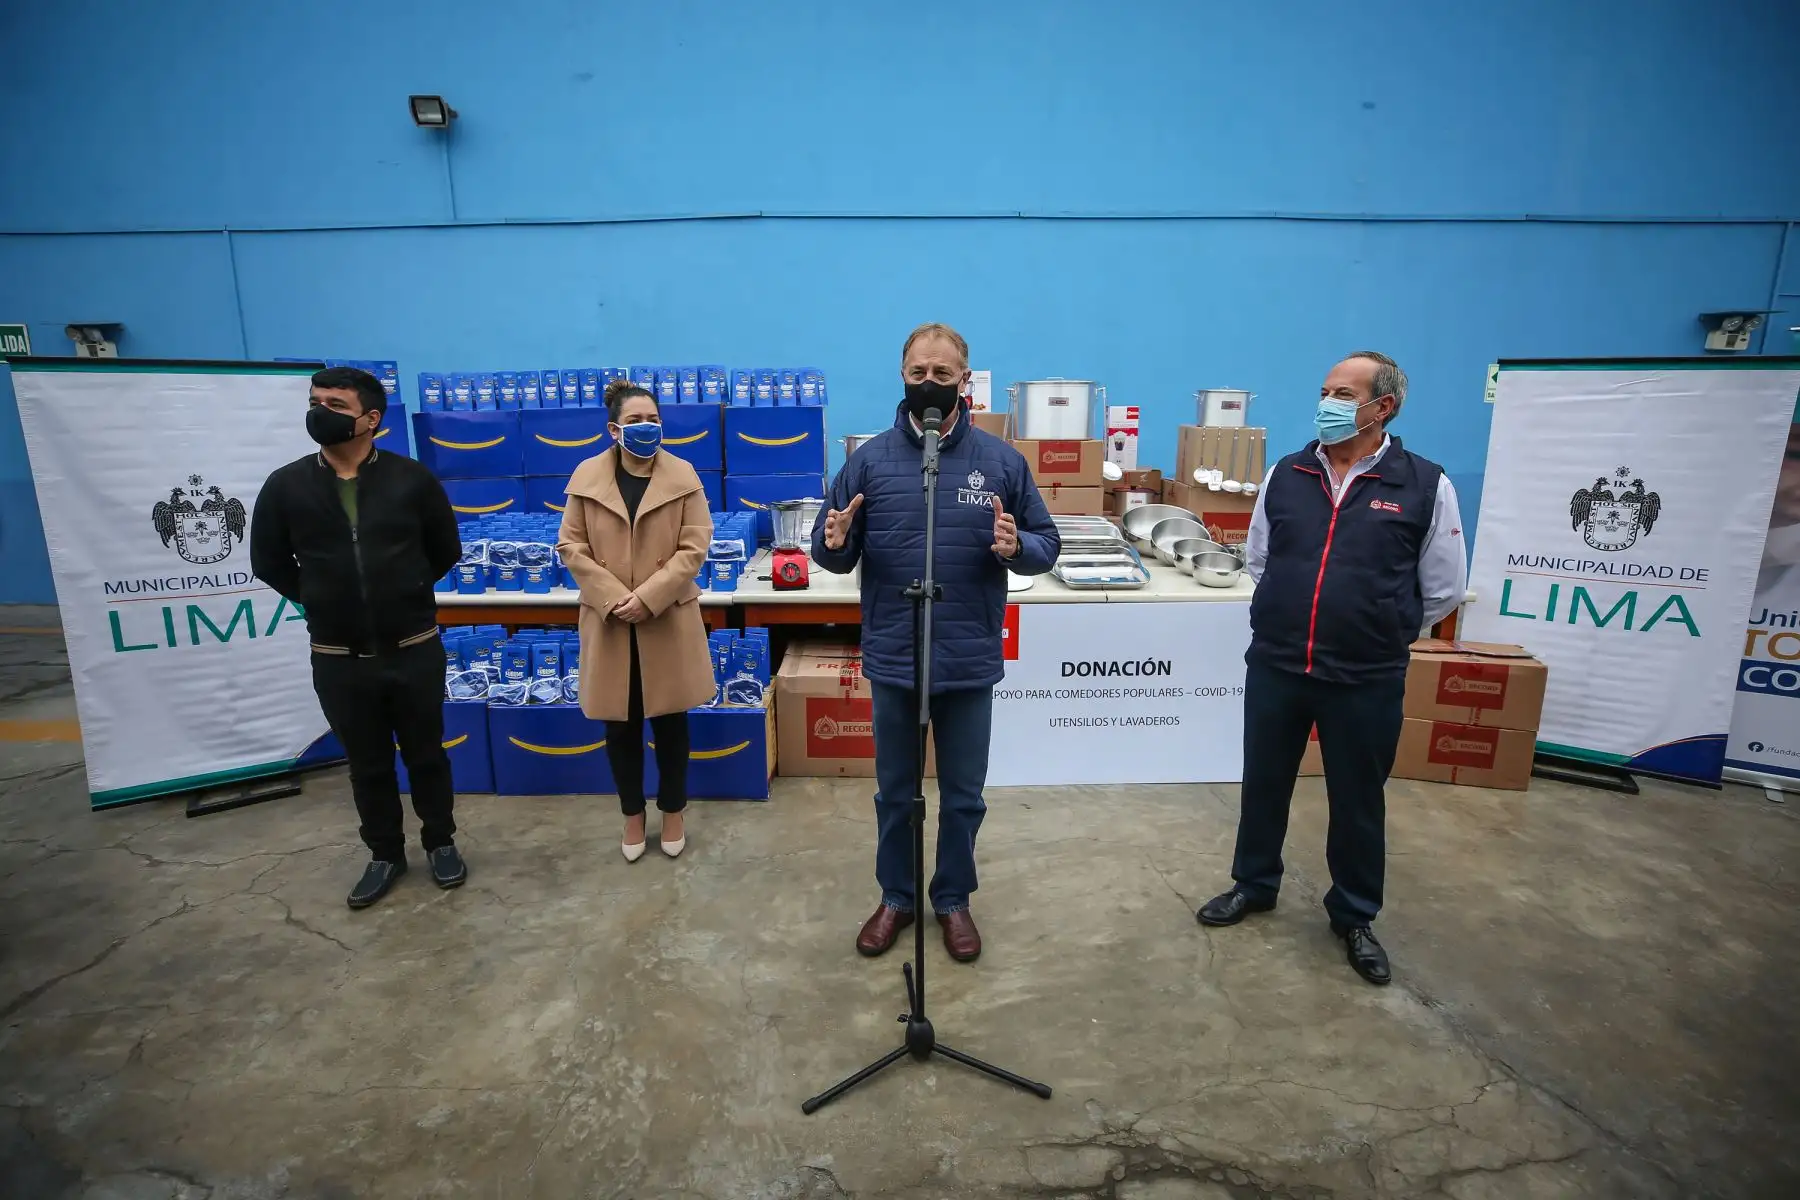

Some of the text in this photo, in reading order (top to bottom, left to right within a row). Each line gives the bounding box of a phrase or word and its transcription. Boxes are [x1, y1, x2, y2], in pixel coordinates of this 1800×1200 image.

[1613, 480, 1627, 488] IK
[190, 489, 205, 497] IK
[958, 492, 994, 508] LIMA
[1507, 553, 1710, 582] MUNICIPALIDAD DE
[1499, 578, 1702, 638] LIMA
[108, 595, 306, 653] LIMA
[1748, 608, 1800, 628] Uni
[1061, 657, 1172, 678] DONACIÓN
[992, 689, 1023, 700] POYO
[1025, 689, 1053, 700] PARA
[1054, 688, 1121, 699] COMEDORES
[1123, 687, 1184, 698] POPULARES
[1194, 686, 1244, 697] COVID-19
[842, 725, 872, 733] RECOR
[1049, 716, 1181, 728] UTENSILIOS Y LAVADEROS
